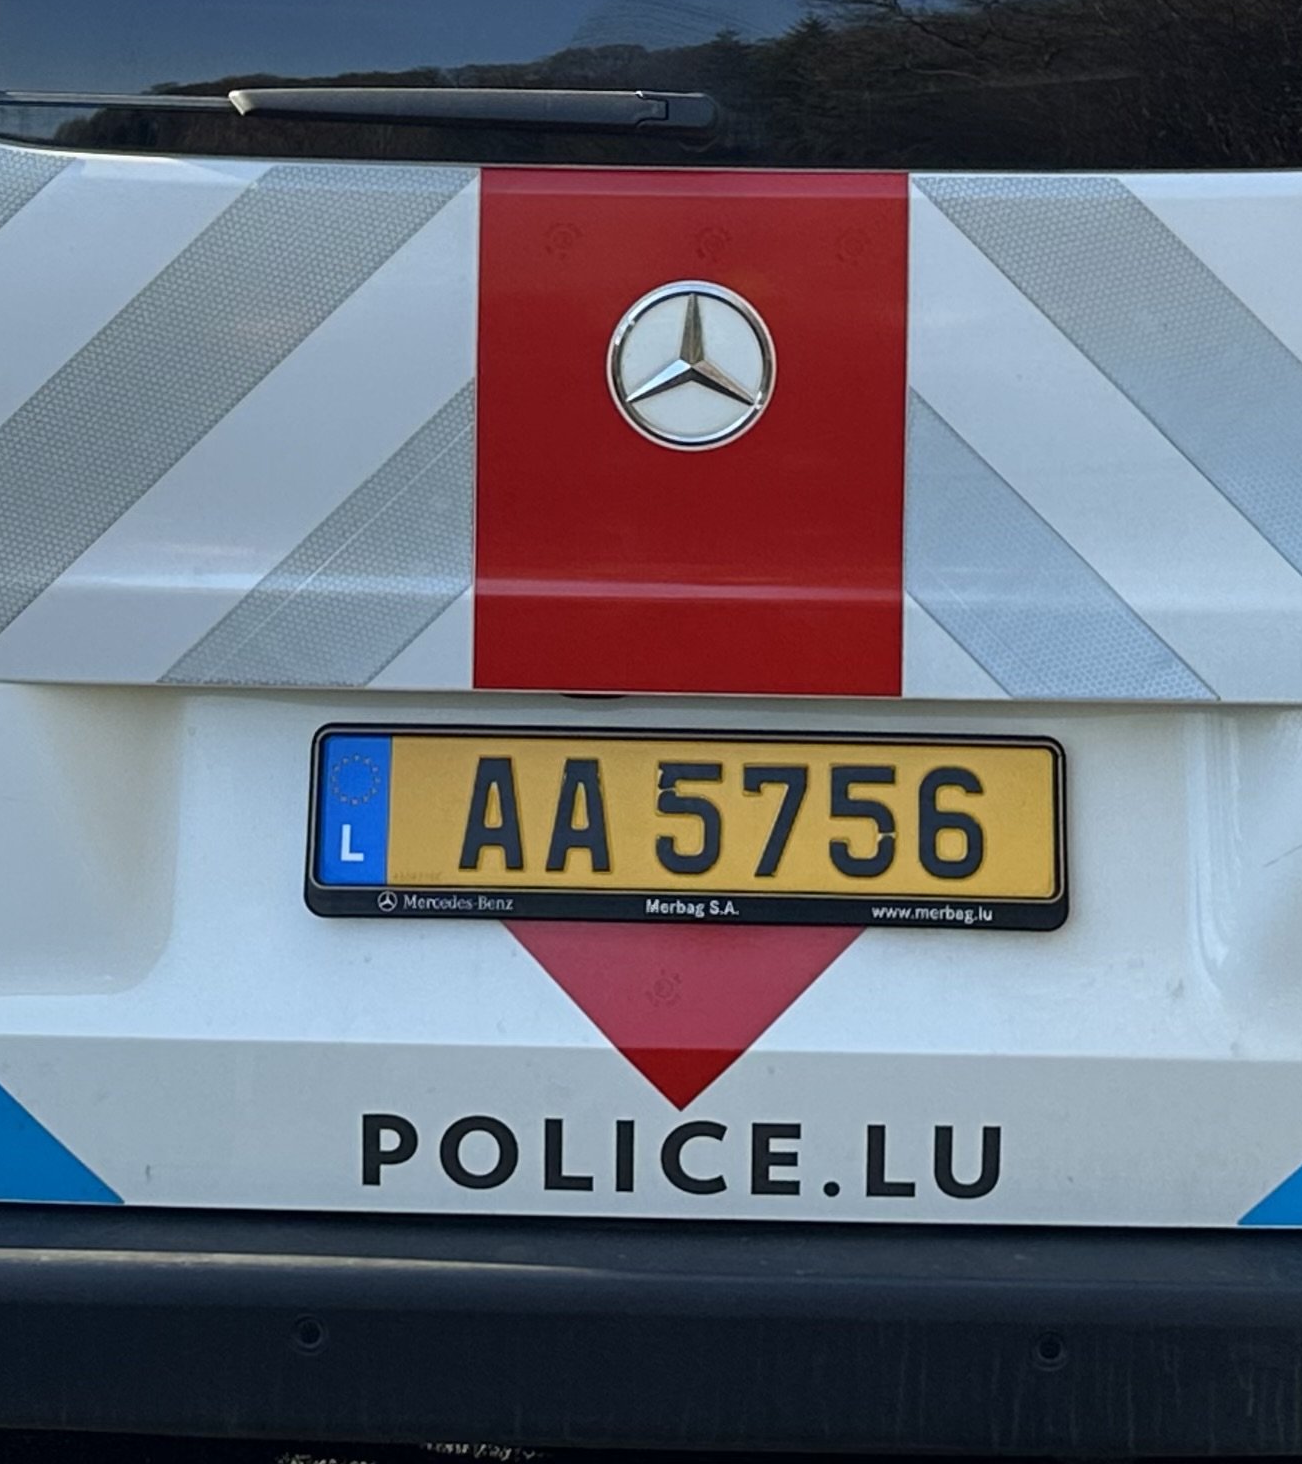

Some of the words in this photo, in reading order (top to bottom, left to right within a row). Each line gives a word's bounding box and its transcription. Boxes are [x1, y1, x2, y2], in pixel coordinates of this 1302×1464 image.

[458, 756, 613, 873] AA
[655, 761, 985, 880] 5756
[340, 824, 364, 862] L
[403, 895, 514, 911] Mercedes-Benz
[645, 899, 705, 918] Merbag
[709, 900, 739, 915] S.A.
[871, 905, 993, 924] www.merbag.lu
[360, 1113, 1003, 1200] POLICE.LU
